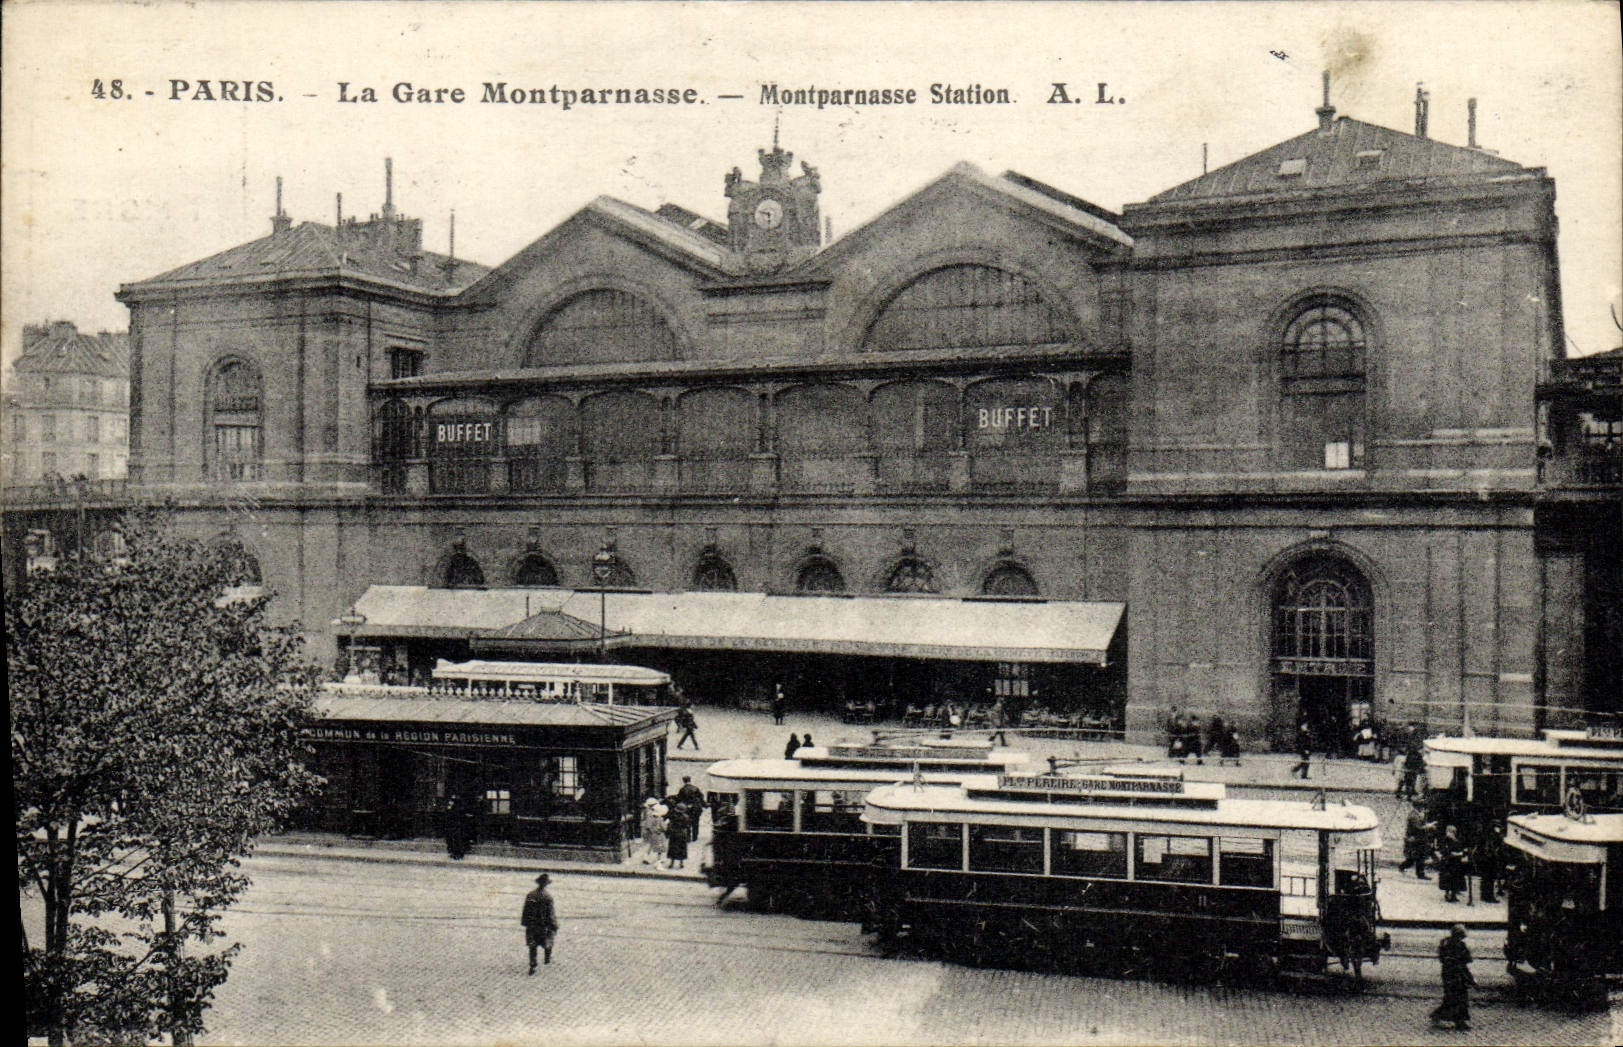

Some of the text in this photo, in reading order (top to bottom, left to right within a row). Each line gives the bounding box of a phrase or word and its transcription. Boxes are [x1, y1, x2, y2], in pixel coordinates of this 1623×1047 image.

[978, 407, 1051, 428] BUFFET
[438, 423, 492, 442] BUFFET
[445, 733, 516, 745] PARISIENNE
[1109, 781, 1181, 793] MONTPARNASSE
